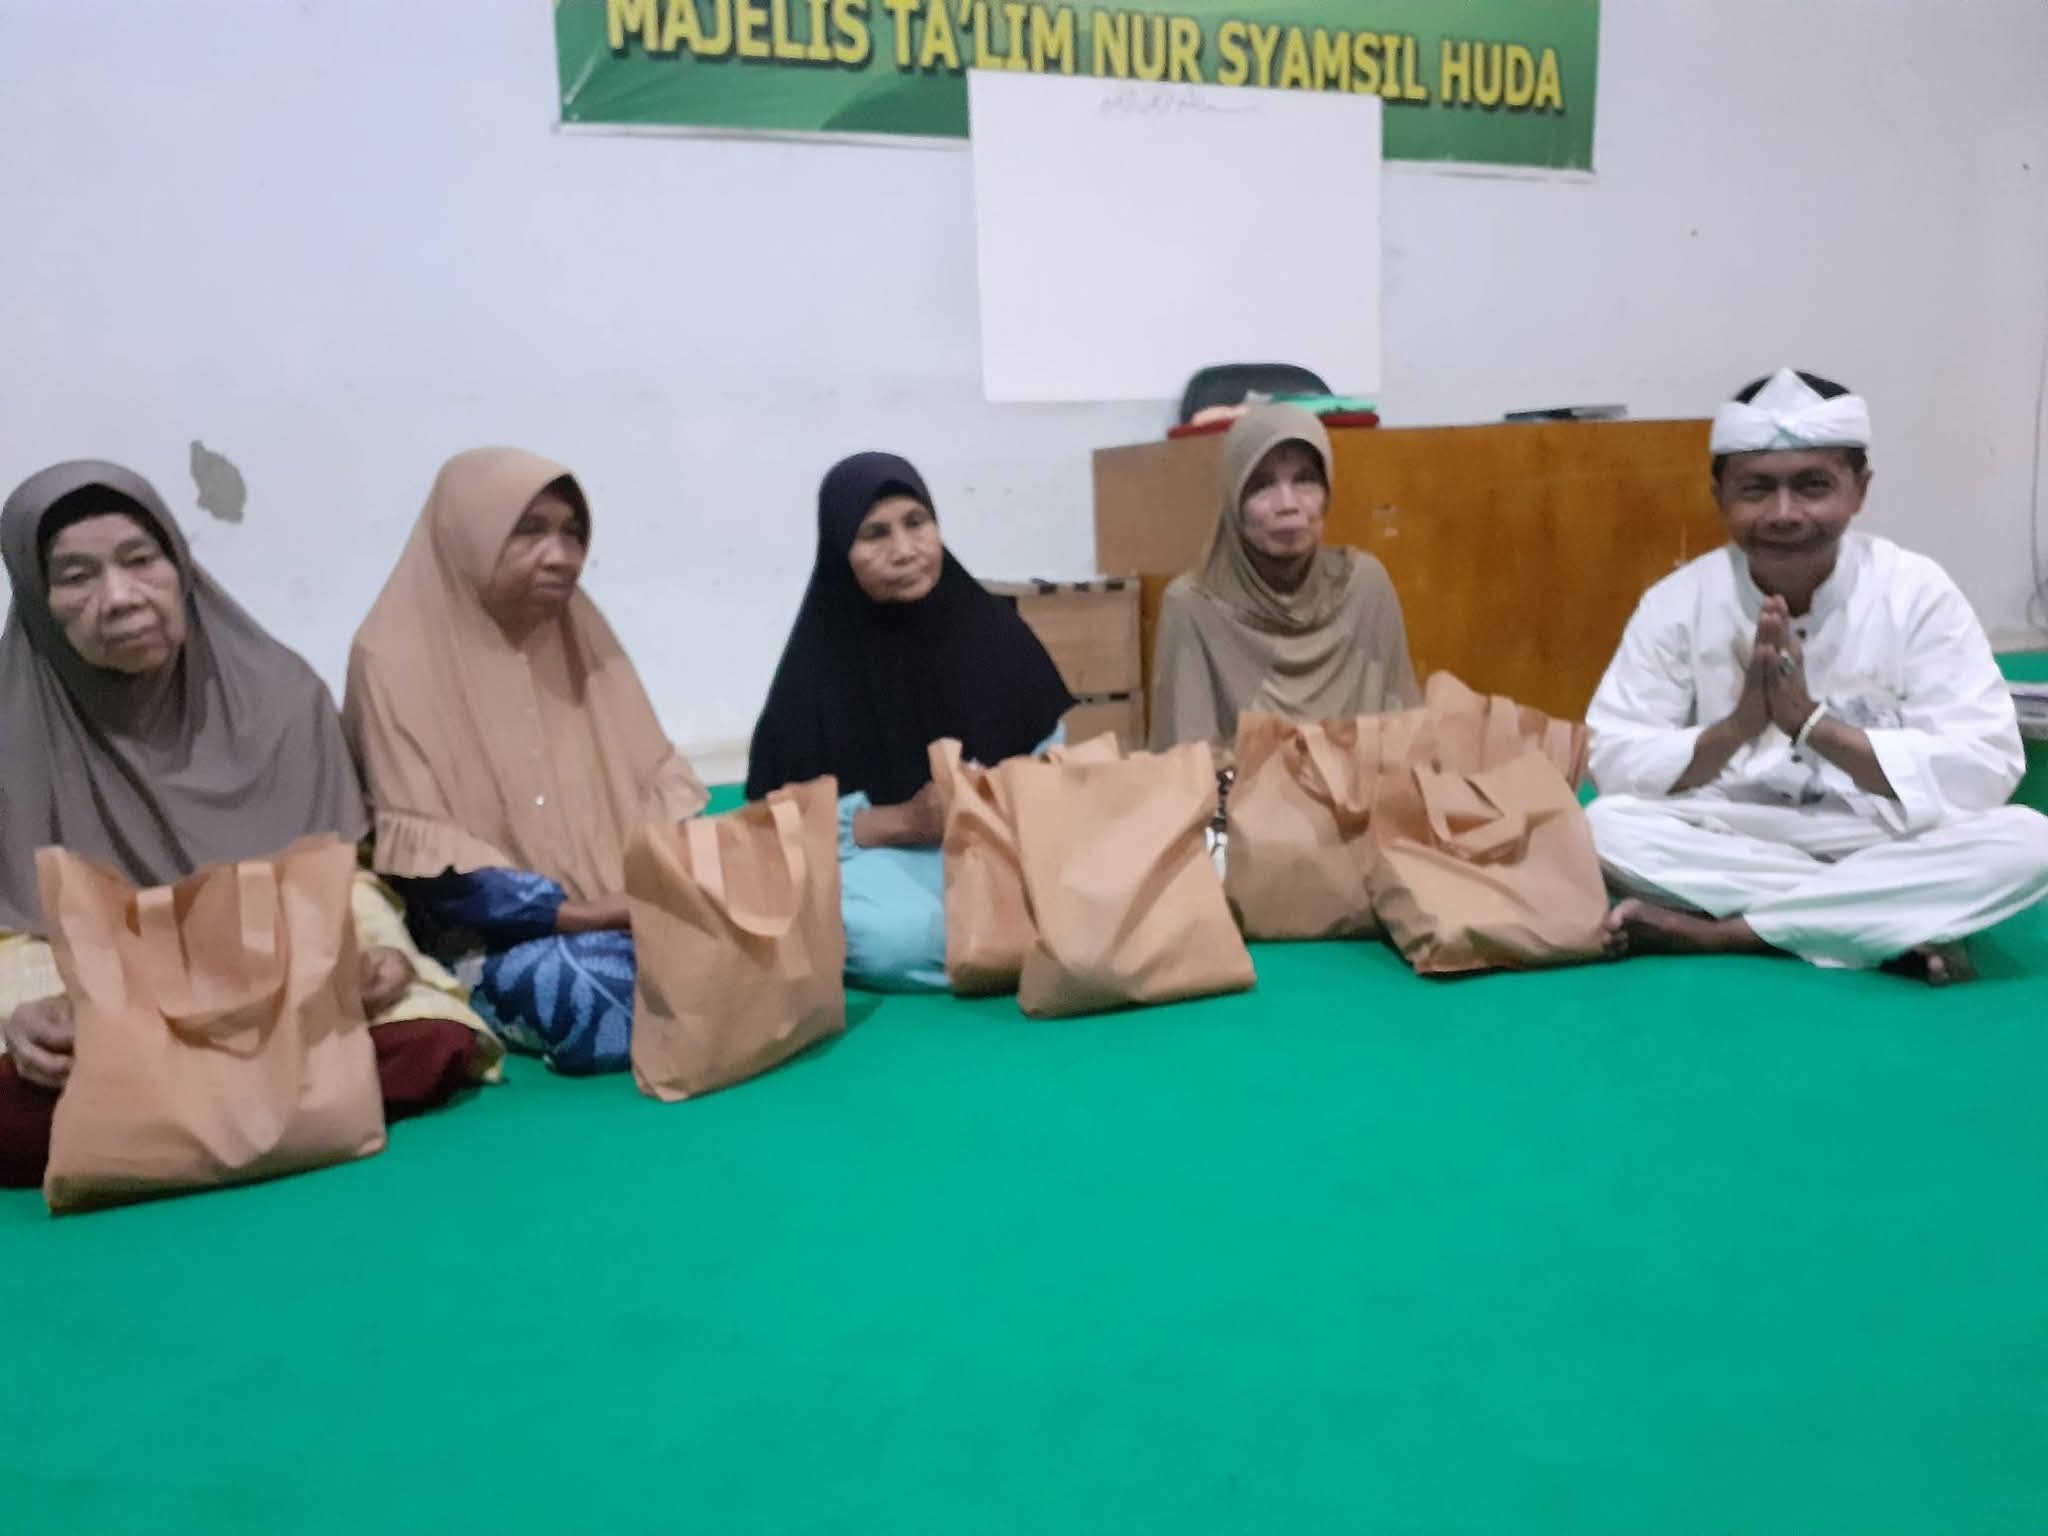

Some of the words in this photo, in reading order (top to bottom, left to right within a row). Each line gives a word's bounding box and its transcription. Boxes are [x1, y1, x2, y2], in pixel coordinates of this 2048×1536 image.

[608, 0, 869, 63] MAJELIS
[1093, 12, 1202, 83] NUR
[1218, 20, 1427, 99] SYAMSIL
[1441, 40, 1562, 109] HUDA
